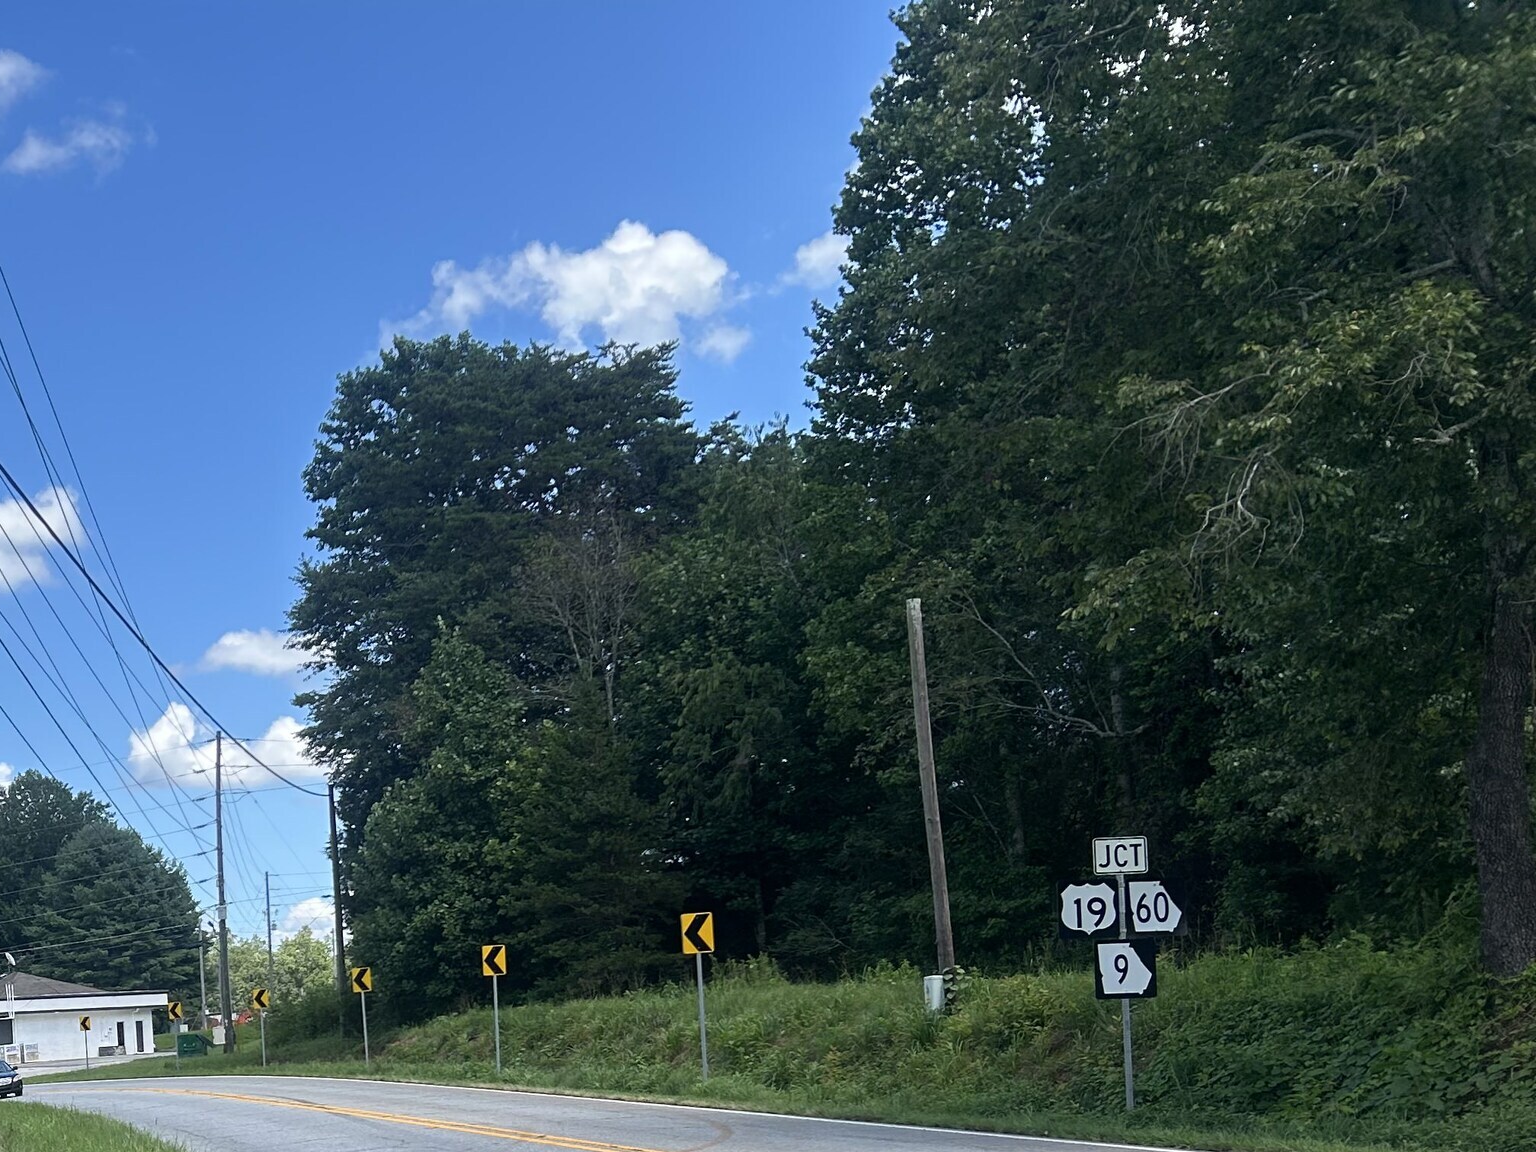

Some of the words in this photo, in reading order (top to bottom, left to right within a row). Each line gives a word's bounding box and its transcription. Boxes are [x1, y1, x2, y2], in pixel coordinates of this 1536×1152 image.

[1098, 843, 1142, 868] JCT
[1073, 897, 1107, 928] 19
[1136, 891, 1170, 924] 60
[1114, 953, 1129, 985] 9
